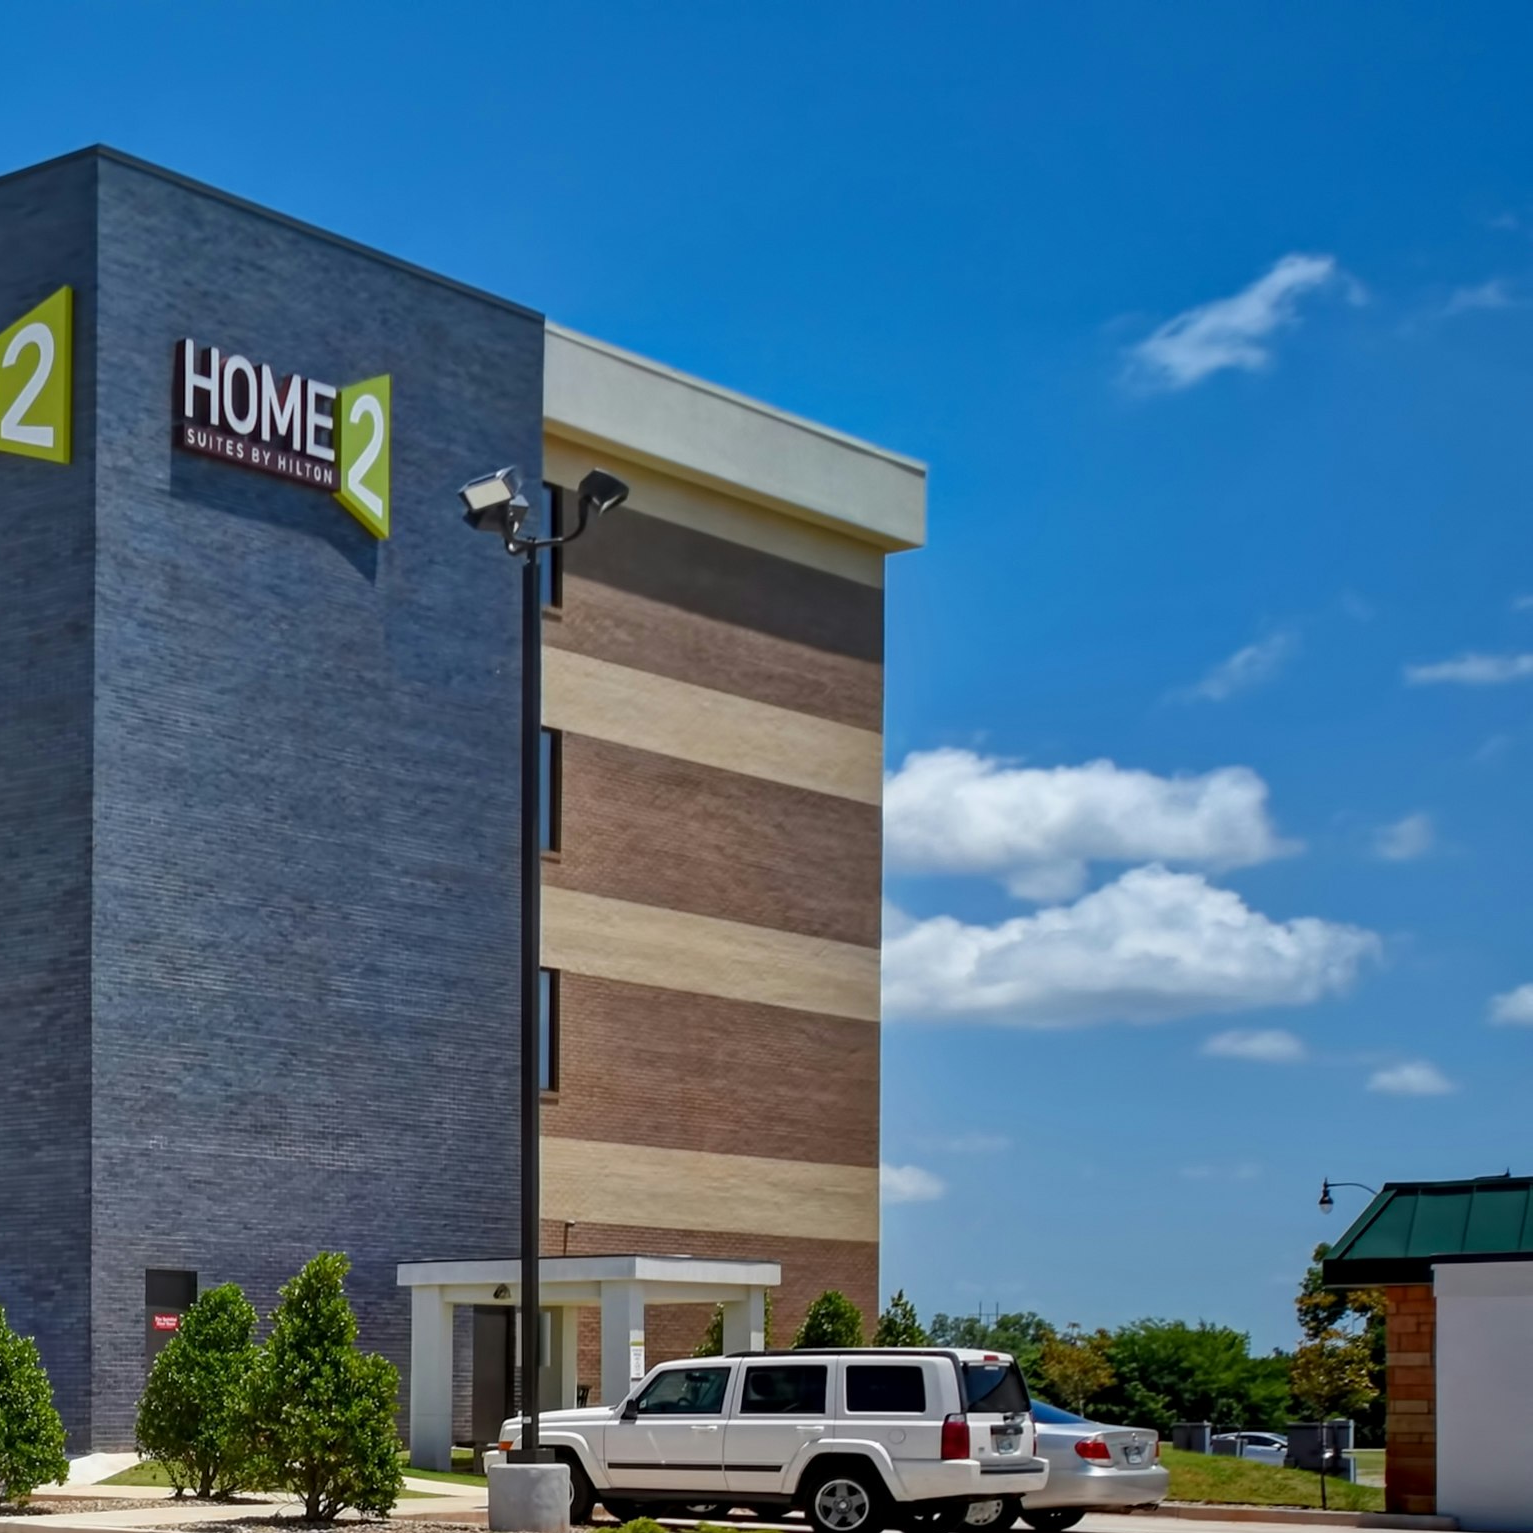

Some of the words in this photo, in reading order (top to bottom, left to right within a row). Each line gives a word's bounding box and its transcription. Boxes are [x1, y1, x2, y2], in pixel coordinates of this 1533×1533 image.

[0, 322, 55, 448] 2
[184, 338, 337, 462] HOME
[348, 394, 384, 519] 2
[187, 428, 245, 459] SUITES
[251, 447, 271, 467] BY
[277, 454, 333, 485] HILTON
